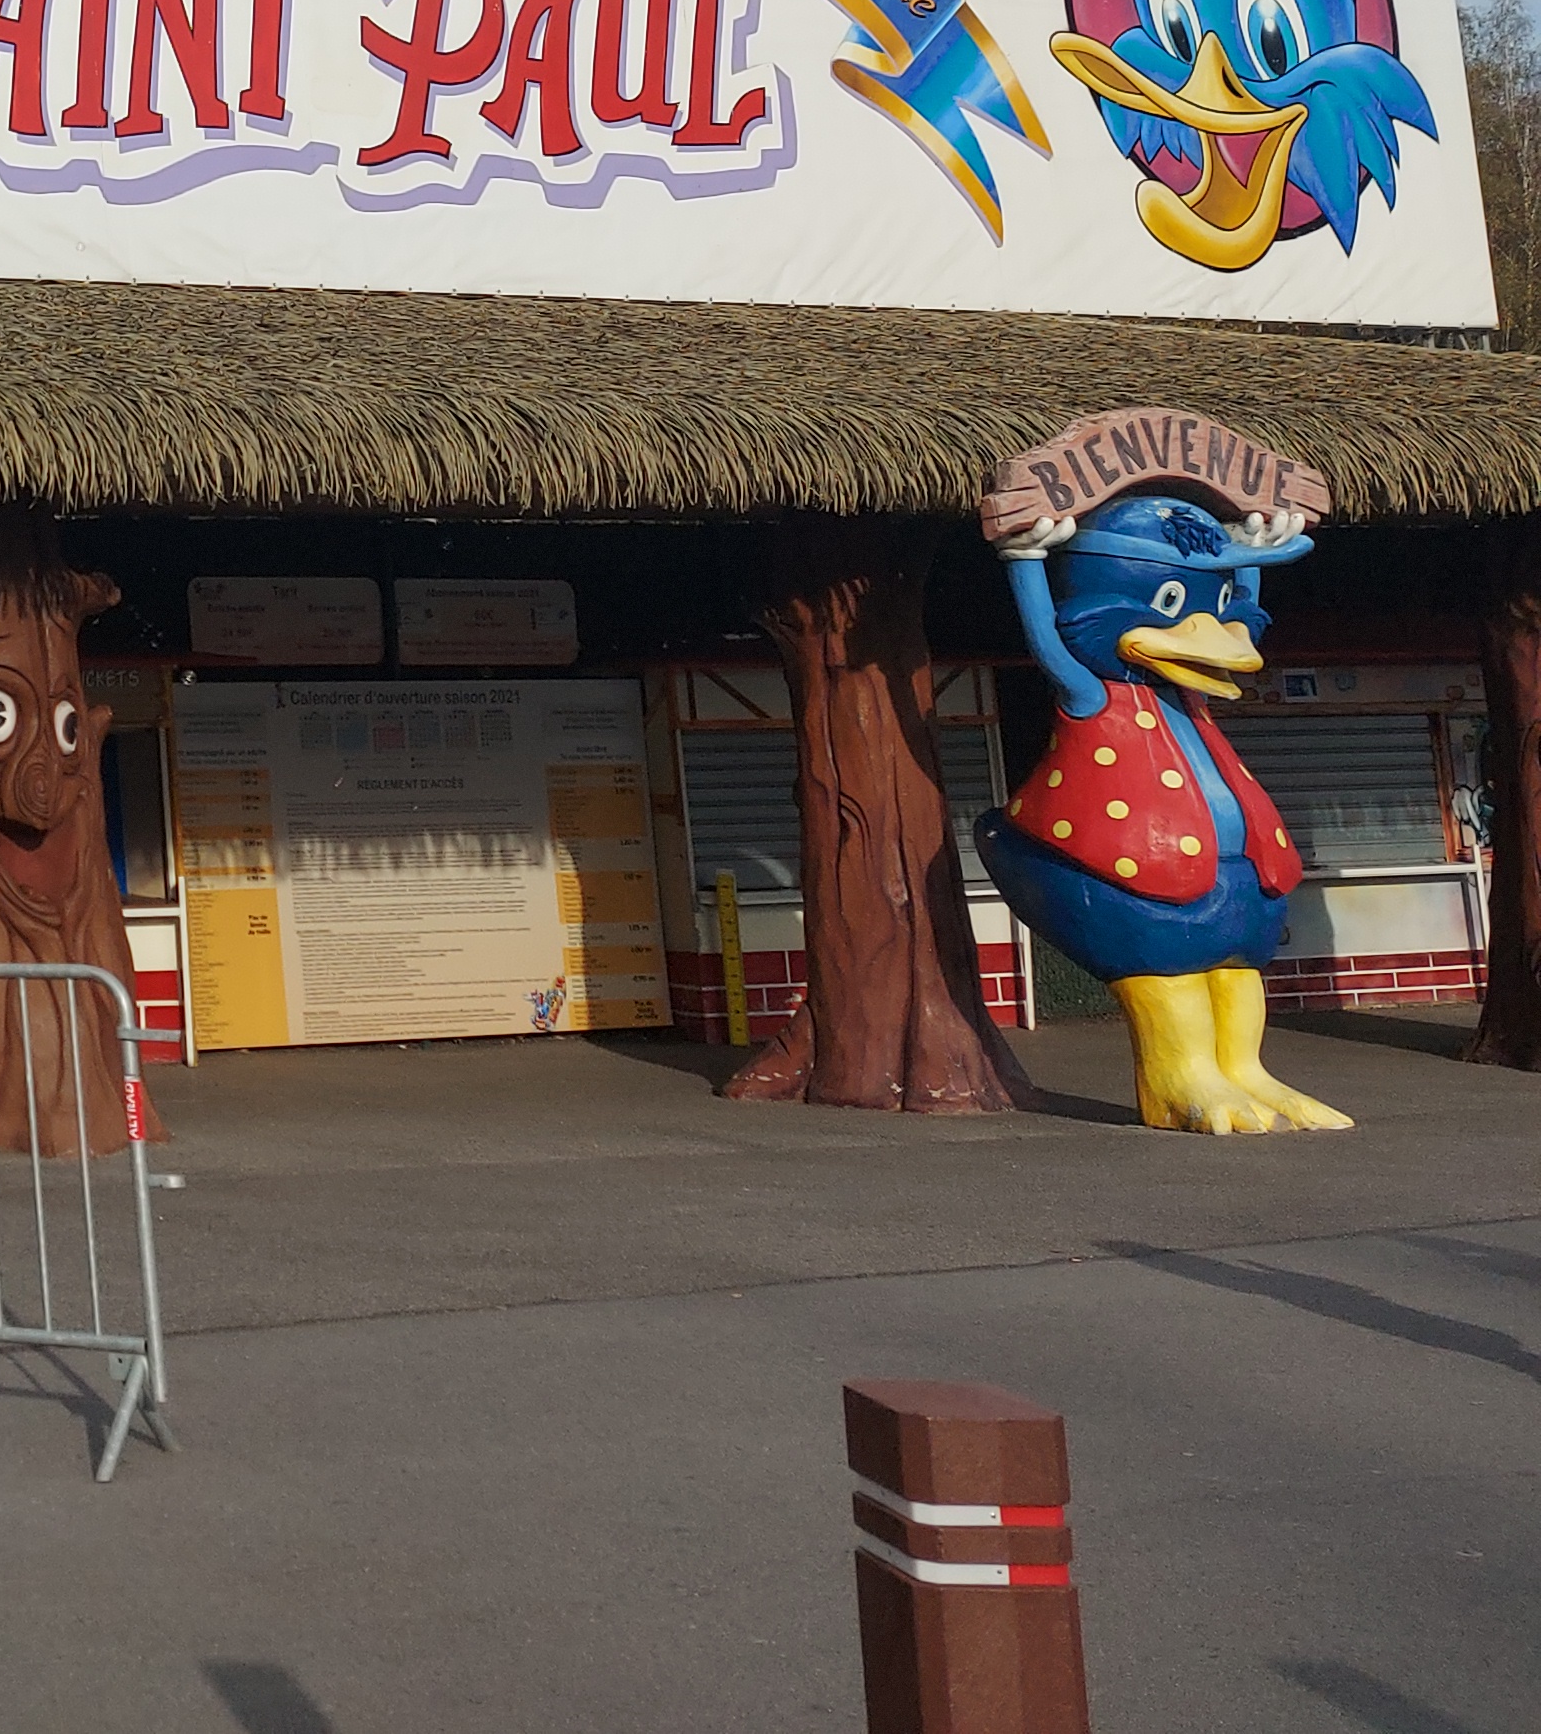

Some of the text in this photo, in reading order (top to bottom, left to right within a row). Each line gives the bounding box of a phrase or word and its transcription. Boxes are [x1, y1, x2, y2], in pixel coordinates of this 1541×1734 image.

[1027, 415, 1296, 512] BIENVENUE
[81, 669, 139, 687] ICKETS
[290, 690, 361, 706] Calendrier
[366, 690, 441, 706] d'ouverture
[444, 692, 487, 705] saison
[124, 1082, 140, 1140] ALTRAD
